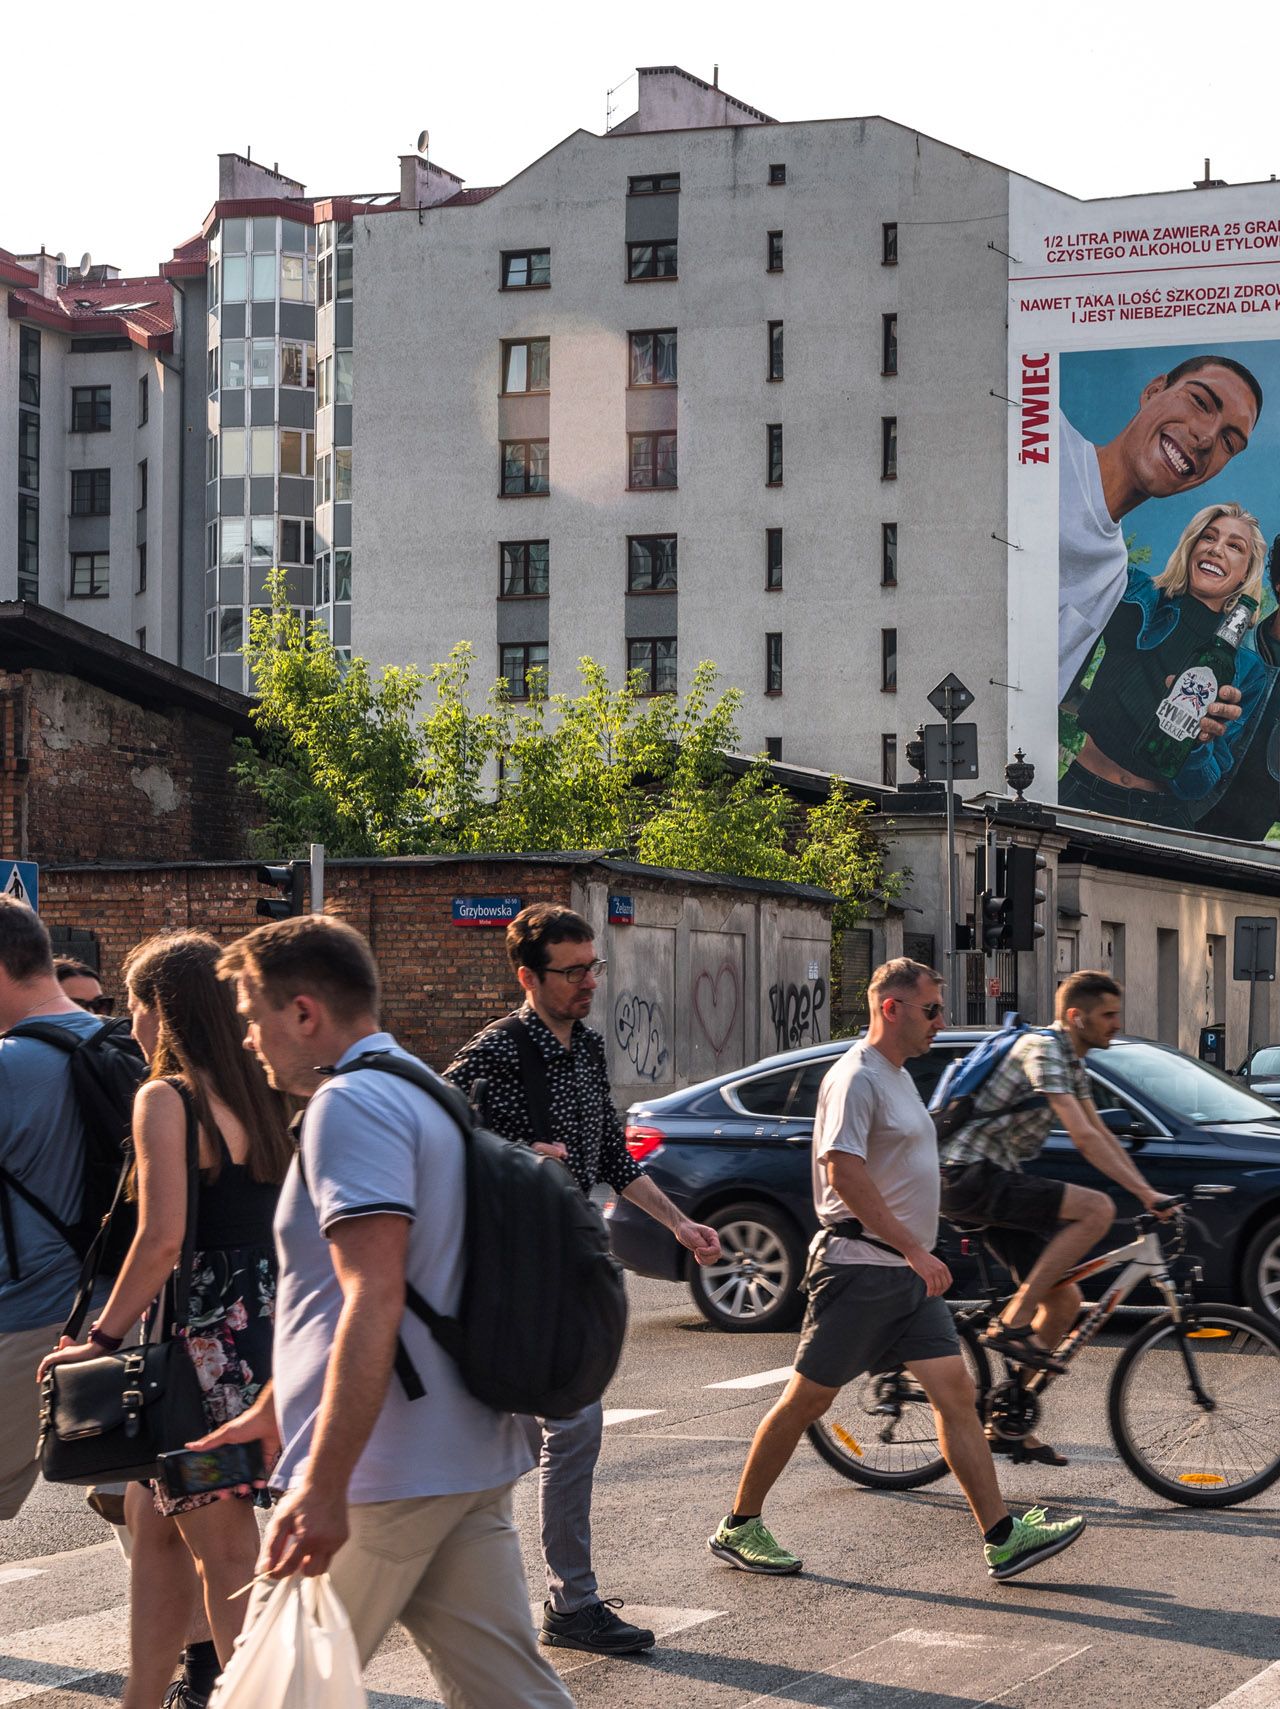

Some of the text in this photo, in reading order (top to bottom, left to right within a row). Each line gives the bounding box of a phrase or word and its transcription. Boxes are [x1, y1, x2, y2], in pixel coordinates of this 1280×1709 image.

[1043, 236, 1064, 248] 1/2
[1067, 232, 1109, 247] LITRA
[1113, 229, 1150, 243] PIWA
[1152, 224, 1221, 241] ZAWIERA
[1224, 222, 1240, 236] 25
[1046, 245, 1126, 263] CZYSTEGO
[1128, 239, 1211, 258] ALKOHOLU
[1020, 297, 1072, 312] NAWET
[1075, 294, 1115, 308] TAKA
[1117, 288, 1162, 306] ILOŚĆ
[1166, 286, 1231, 303] SZKODZI
[1071, 311, 1076, 324] I
[1079, 308, 1116, 323] JEST
[1119, 301, 1237, 321] NIEBEZPIECZNA
[1241, 299, 1271, 313] DLA
[1018, 352, 1050, 465] ŻYWIEC
[459, 903, 513, 920] Grzybowska
[1207, 1033, 1216, 1046] P
